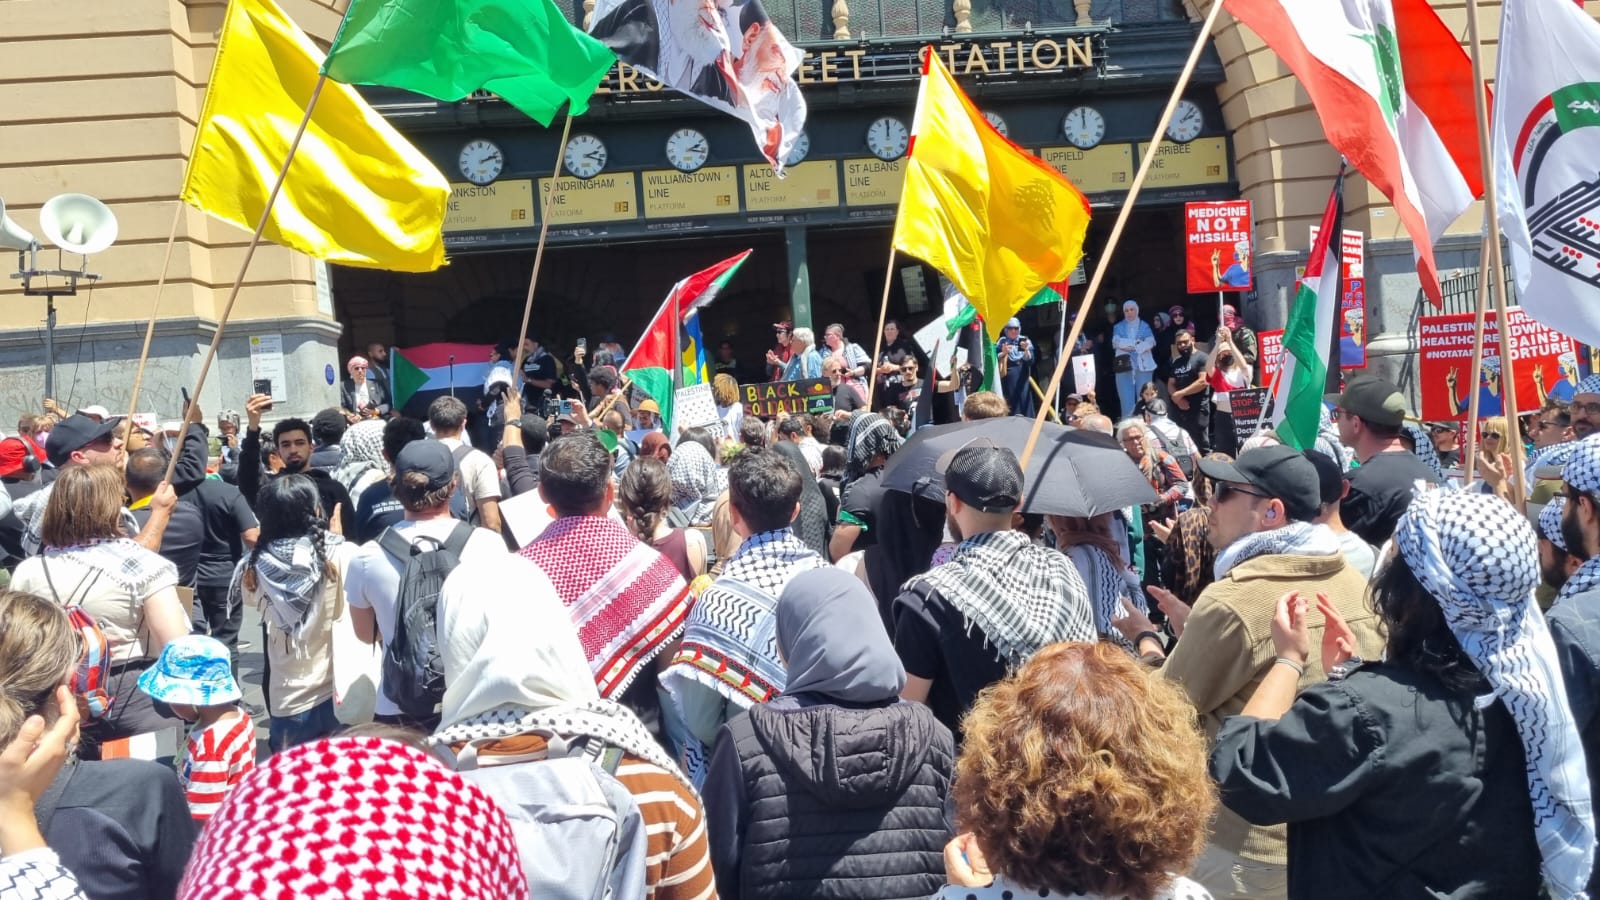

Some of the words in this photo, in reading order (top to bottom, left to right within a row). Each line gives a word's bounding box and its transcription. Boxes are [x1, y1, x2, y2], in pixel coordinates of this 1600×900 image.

[799, 50, 866, 83] EET
[1046, 152, 1084, 161] UPFIELD
[750, 168, 776, 178] ALTO
[849, 164, 860, 173] ST
[863, 162, 899, 172] ALBANS
[648, 172, 721, 185] WILLIAMSTOWN
[849, 177, 870, 186] LINE
[544, 179, 615, 192] SNDRINGHAM
[750, 181, 770, 191] LINE
[450, 187, 496, 197] ANKSTON
[648, 188, 669, 198] LINE
[1188, 206, 1247, 218] MEDICINE
[1197, 217, 1240, 232] NOT
[1189, 232, 1248, 243] MISSILES
[1422, 321, 1498, 334] PALESTINAN
[1422, 334, 1500, 346] HEALTHCRE
[1426, 348, 1495, 359] #NOTATARET
[1510, 341, 1570, 360] ORTURE
[747, 383, 800, 402] BLACK
[744, 396, 808, 416] SOLIDARITY
[1232, 398, 1253, 407] STOP
